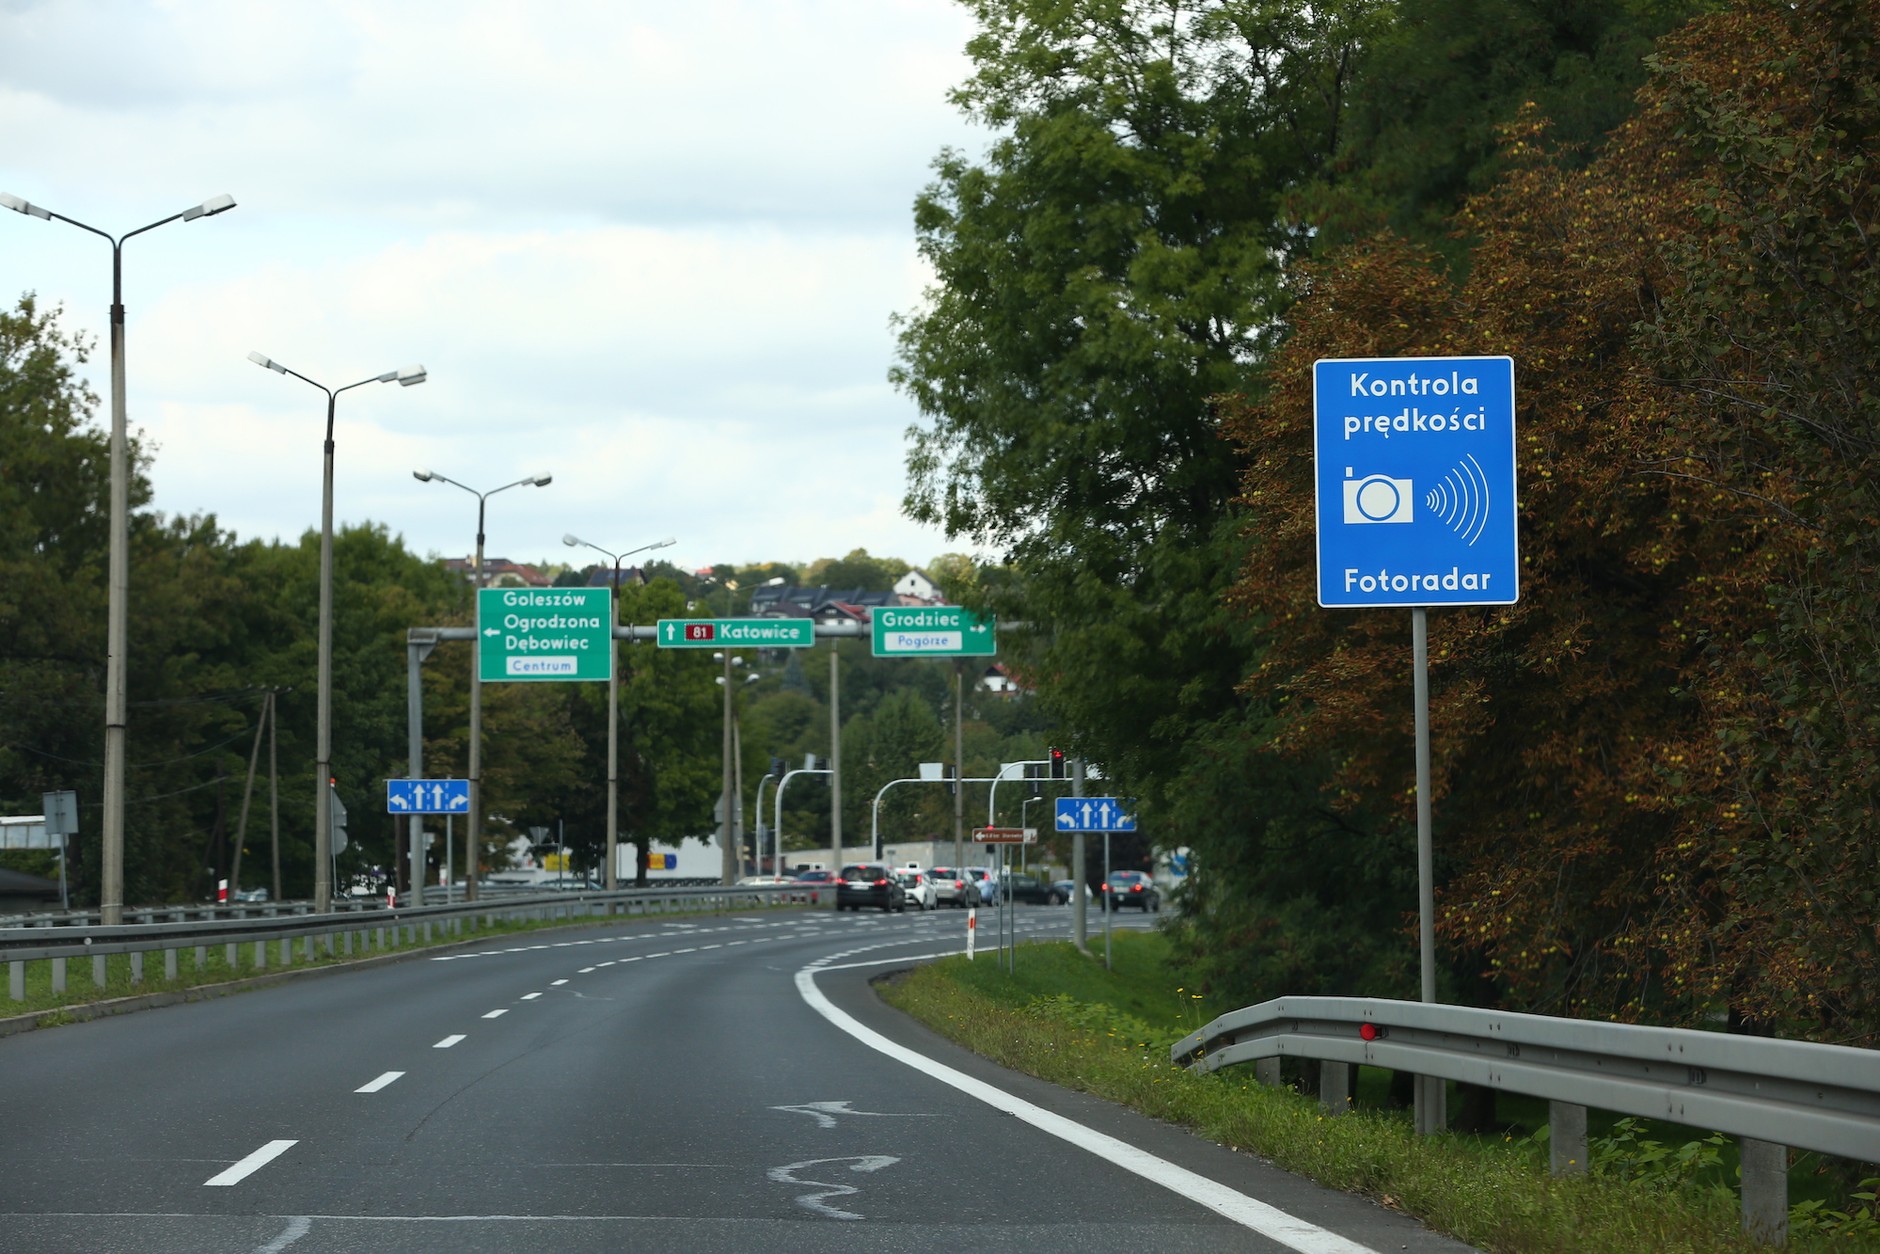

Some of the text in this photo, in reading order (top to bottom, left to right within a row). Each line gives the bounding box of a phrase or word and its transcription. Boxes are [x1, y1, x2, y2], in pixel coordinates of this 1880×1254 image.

[1350, 371, 1479, 397] Kontrola
[1344, 406, 1486, 441] prędkości
[1344, 566, 1491, 593] Fotoradar
[503, 590, 586, 607] Goleszów
[503, 613, 600, 633] Ogrodzona
[881, 611, 960, 628] Grodziec
[692, 623, 800, 640] 81 Katowice
[505, 634, 590, 654] Dębowiec
[897, 634, 949, 649] Pogórze
[512, 659, 572, 672] Centrum
